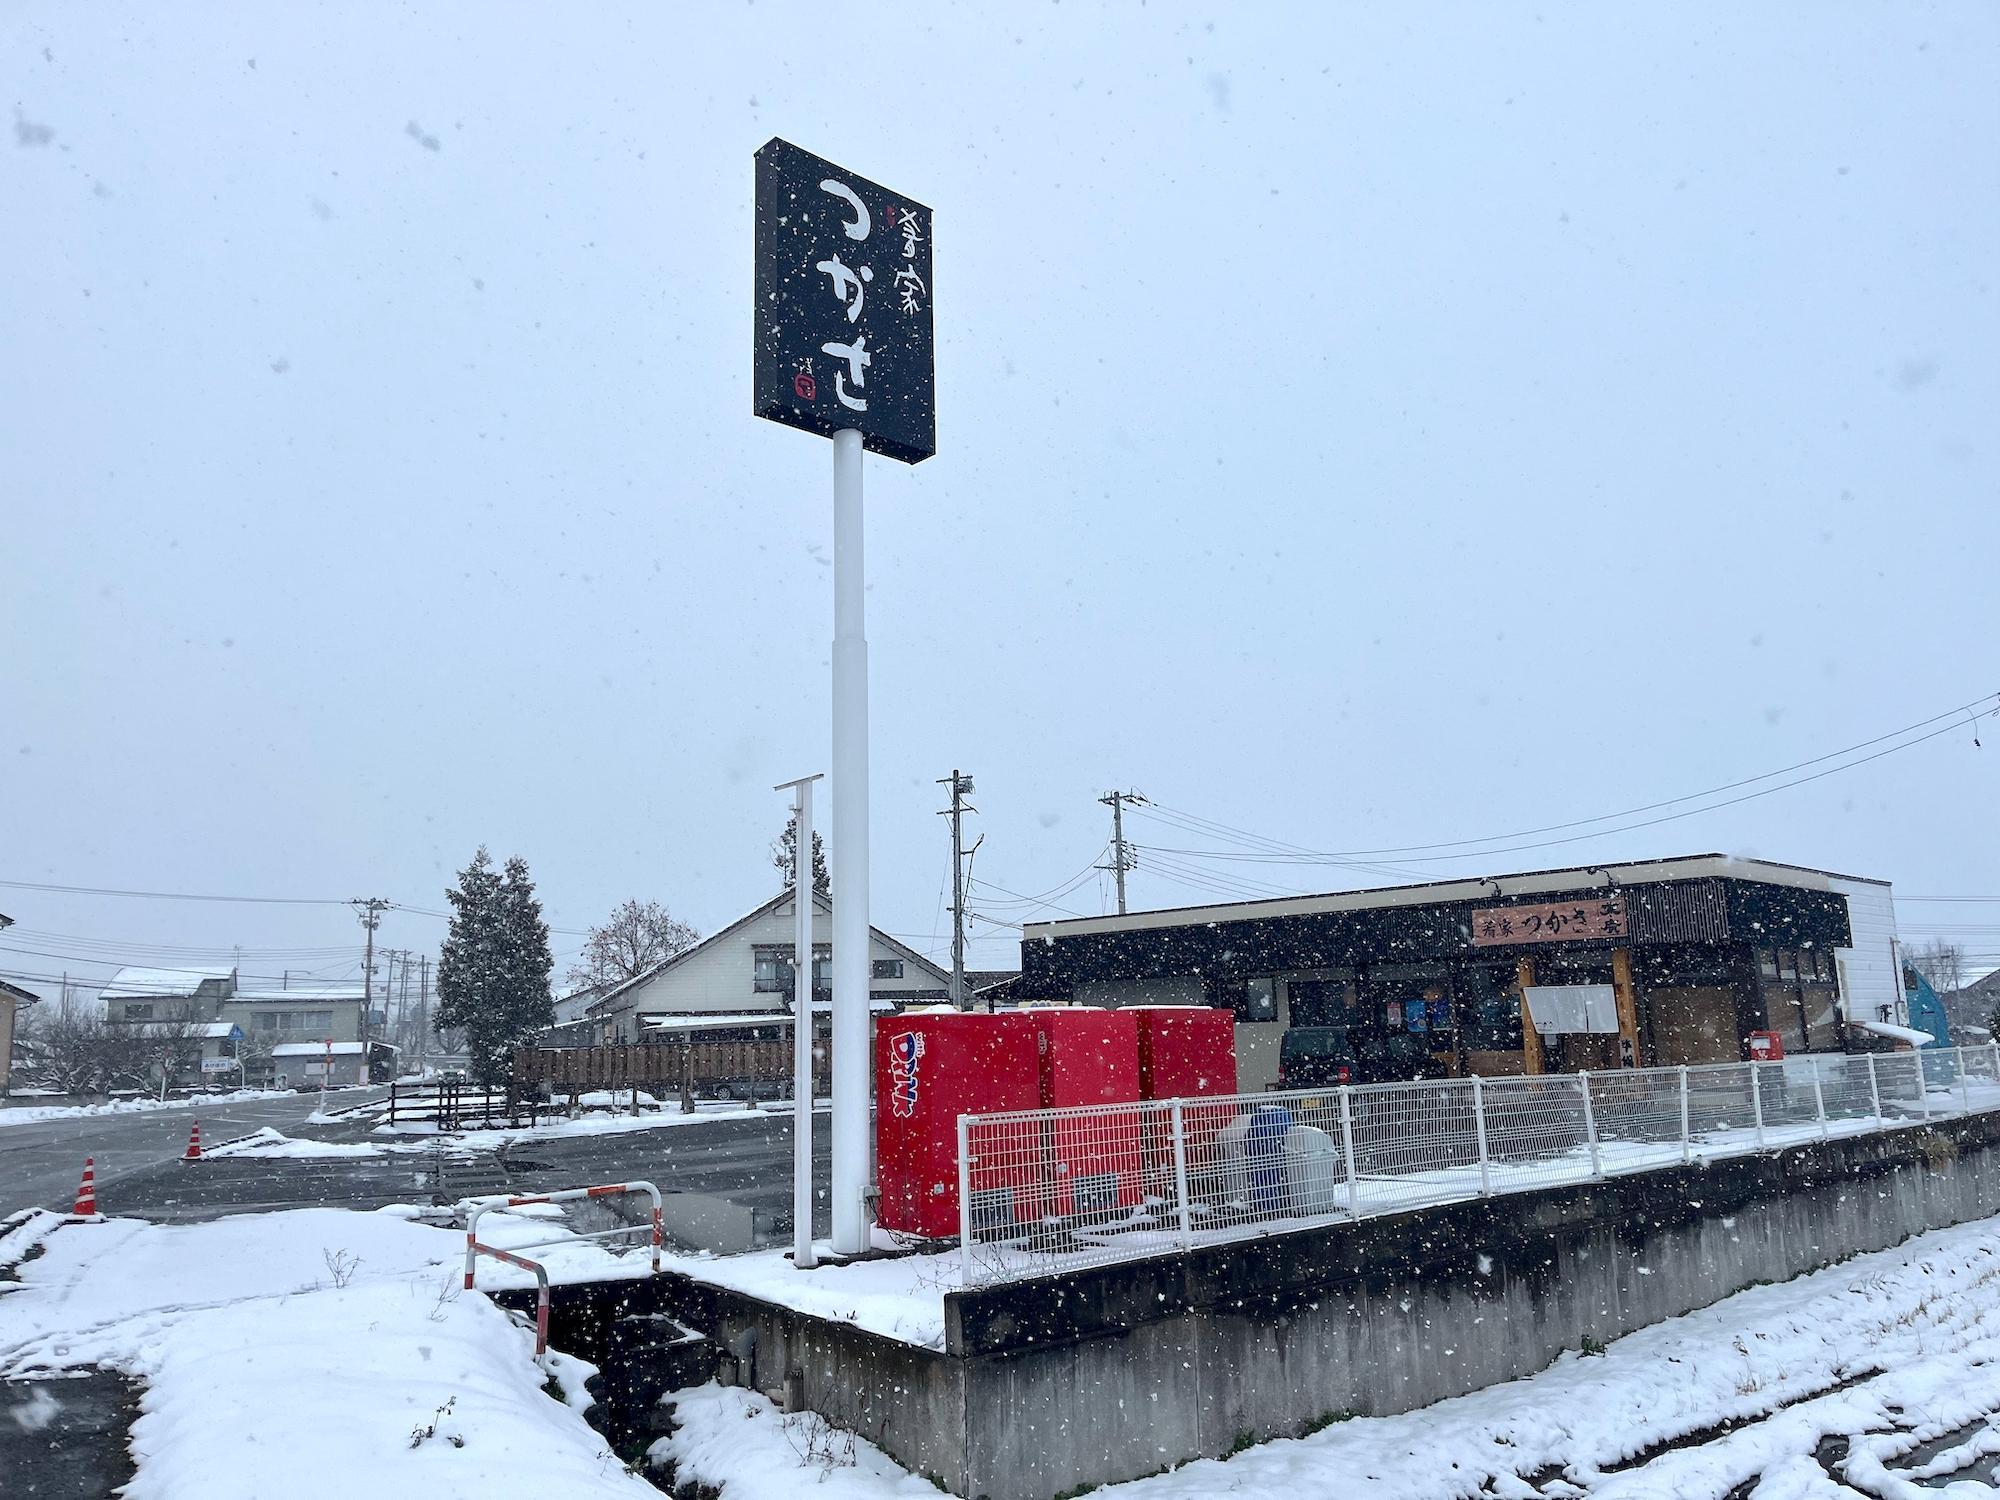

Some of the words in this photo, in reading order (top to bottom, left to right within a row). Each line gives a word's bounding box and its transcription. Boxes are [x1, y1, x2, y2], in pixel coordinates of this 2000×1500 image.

[816, 178, 874, 412] つかさ
[1521, 907, 1588, 936] つかさ
